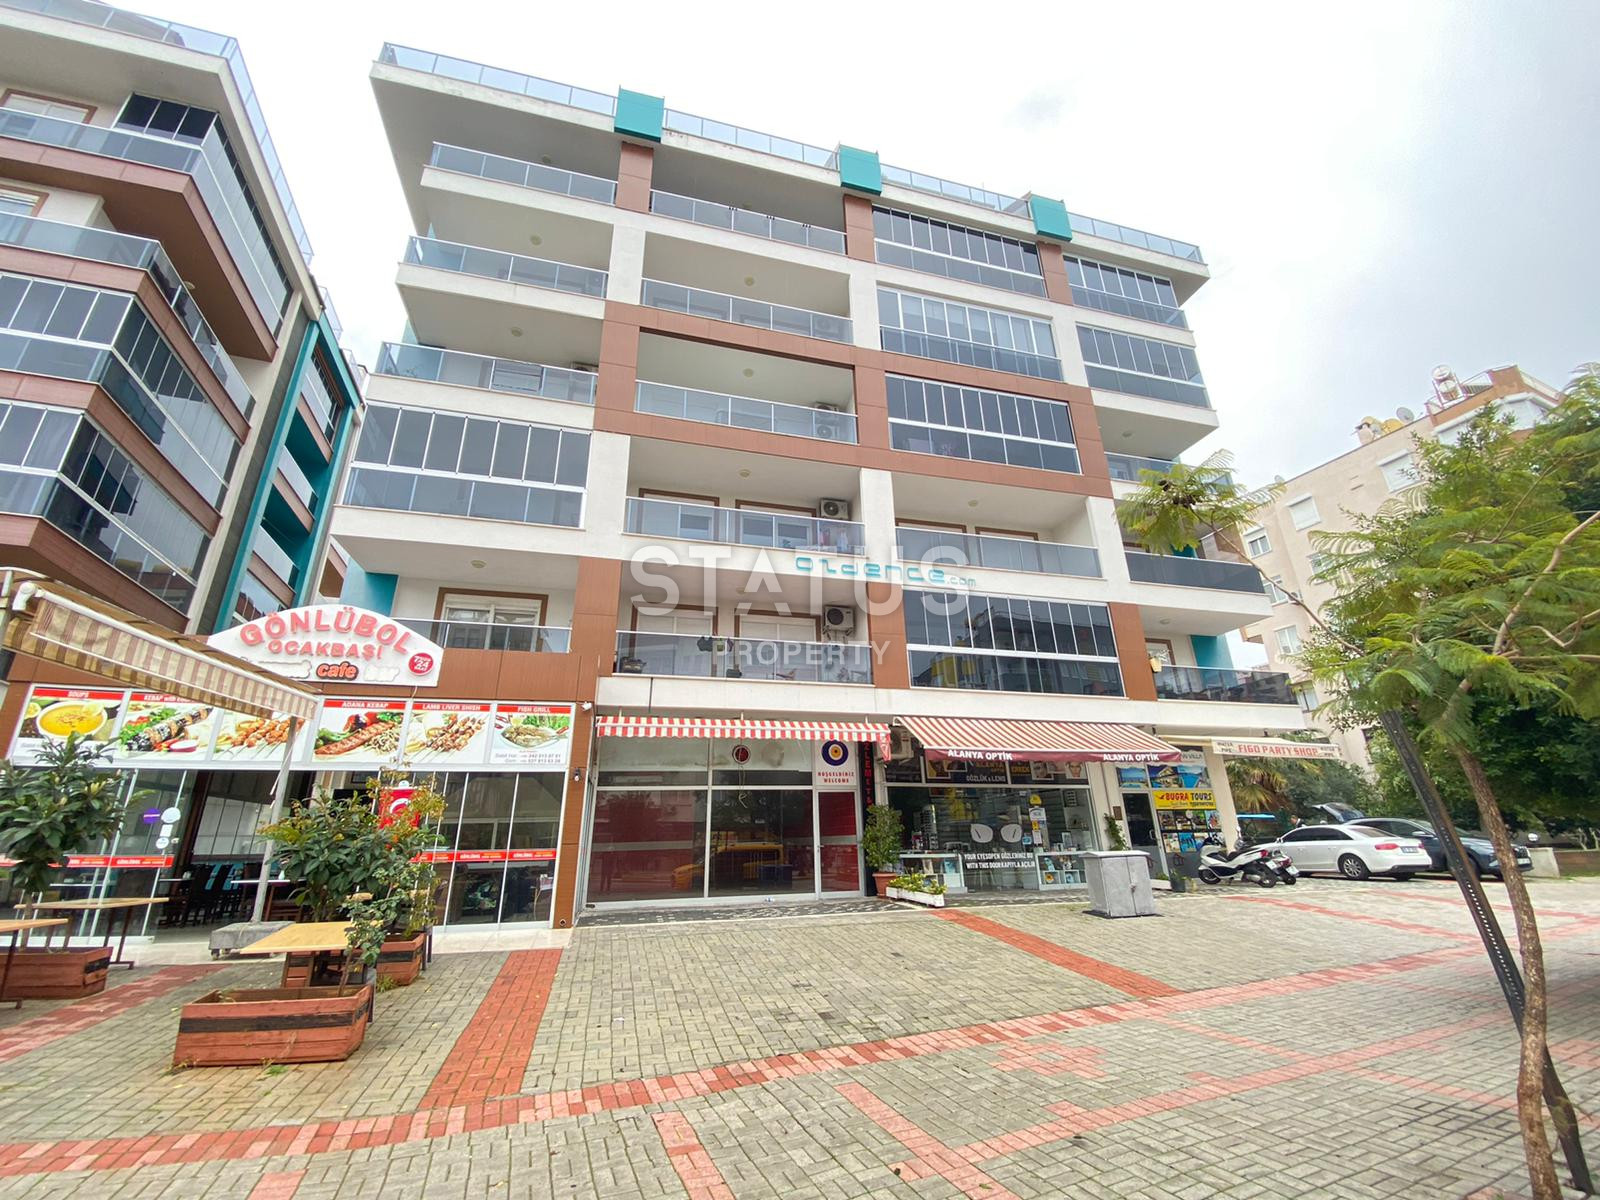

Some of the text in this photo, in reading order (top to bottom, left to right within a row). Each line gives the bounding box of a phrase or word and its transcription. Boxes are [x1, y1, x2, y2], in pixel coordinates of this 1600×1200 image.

[240, 607, 410, 654] GÖNLÜBOL
[316, 661, 359, 680] cafe
[948, 750, 984, 760] ALANYA
[1238, 744, 1318, 757] FIGO PARTY SHOP
[1103, 753, 1134, 761] ALANYA
[1191, 792, 1212, 801] TOURS
